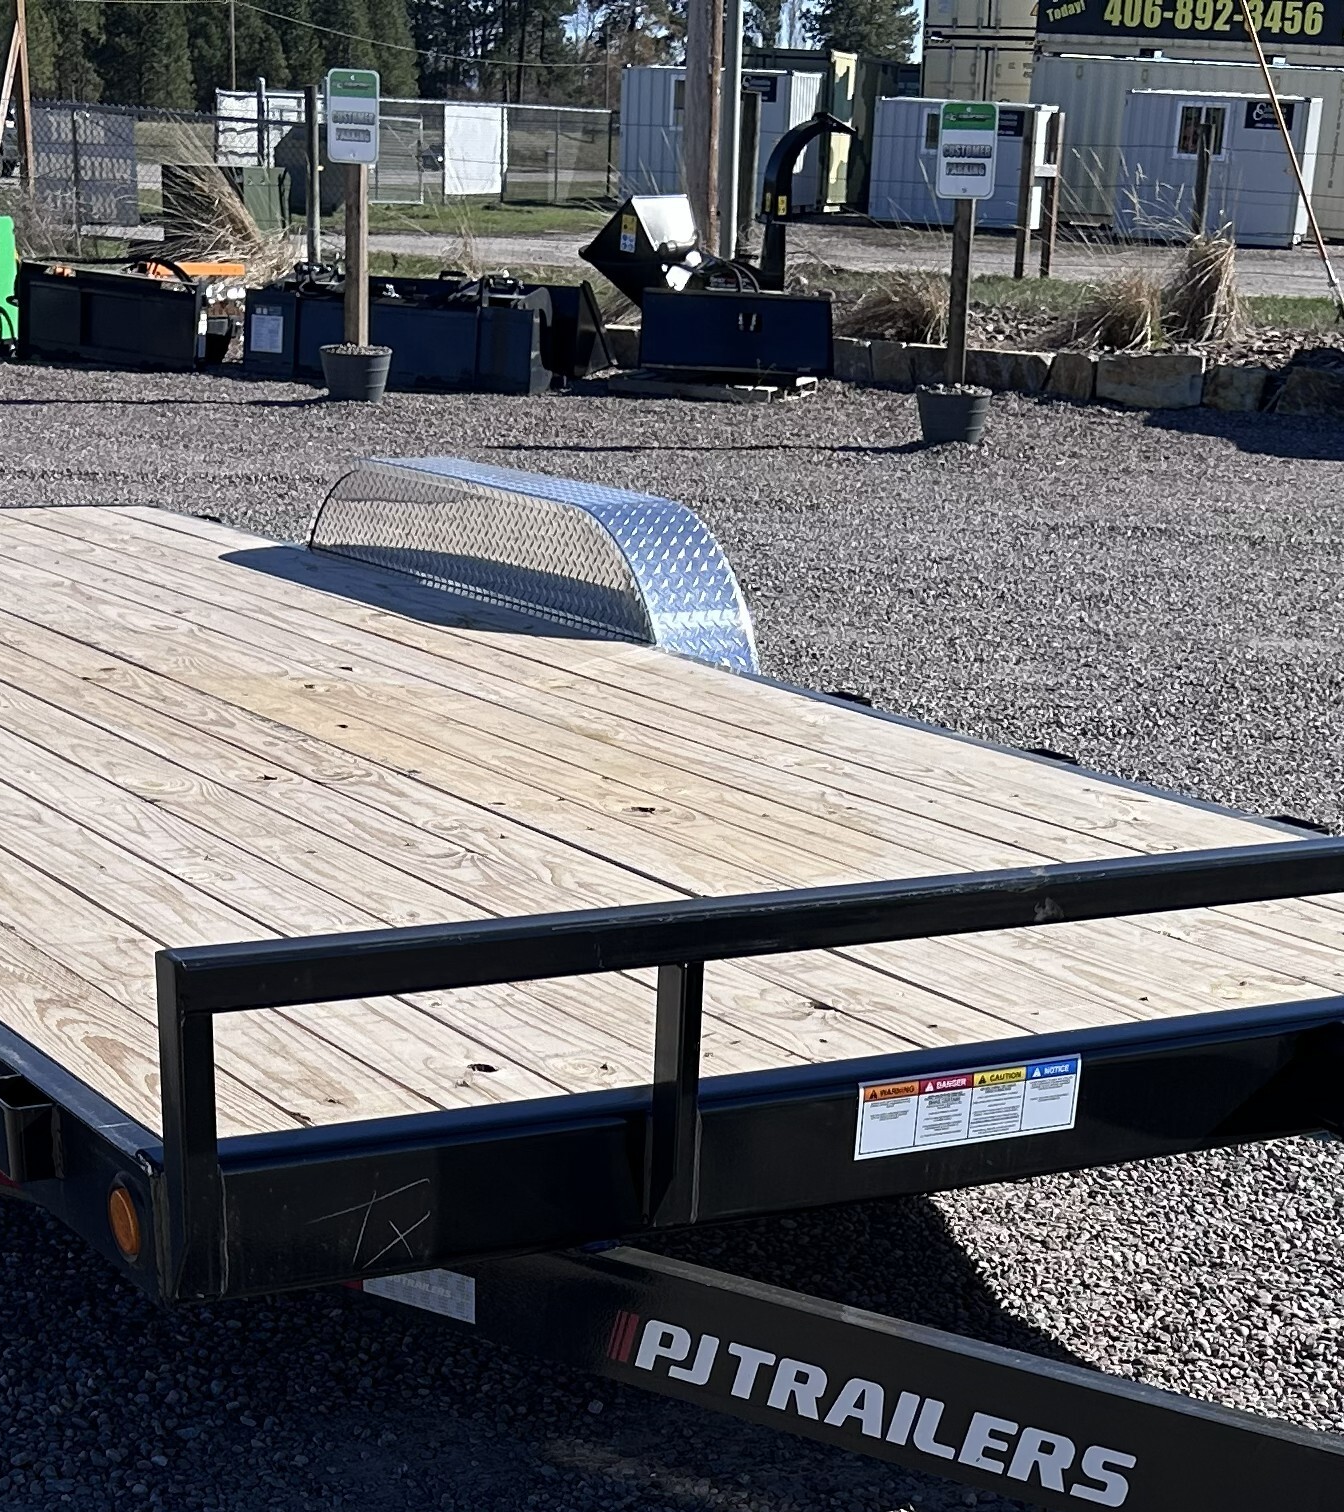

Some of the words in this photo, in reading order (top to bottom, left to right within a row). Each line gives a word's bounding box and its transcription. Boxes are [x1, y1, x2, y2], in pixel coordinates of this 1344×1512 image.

[1046, 0, 1086, 22] Today!
[1103, 0, 1324, 35] 406-892-3456
[943, 143, 993, 158] CUSTOMER
[989, 1070, 1022, 1082] CAUTION
[1043, 1063, 1070, 1075] NOTICE
[879, 1084, 915, 1097] WARNING
[936, 1077, 967, 1090] DANGER
[634, 1319, 720, 1386] PJ
[727, 1341, 1137, 1508] TRAILERS
